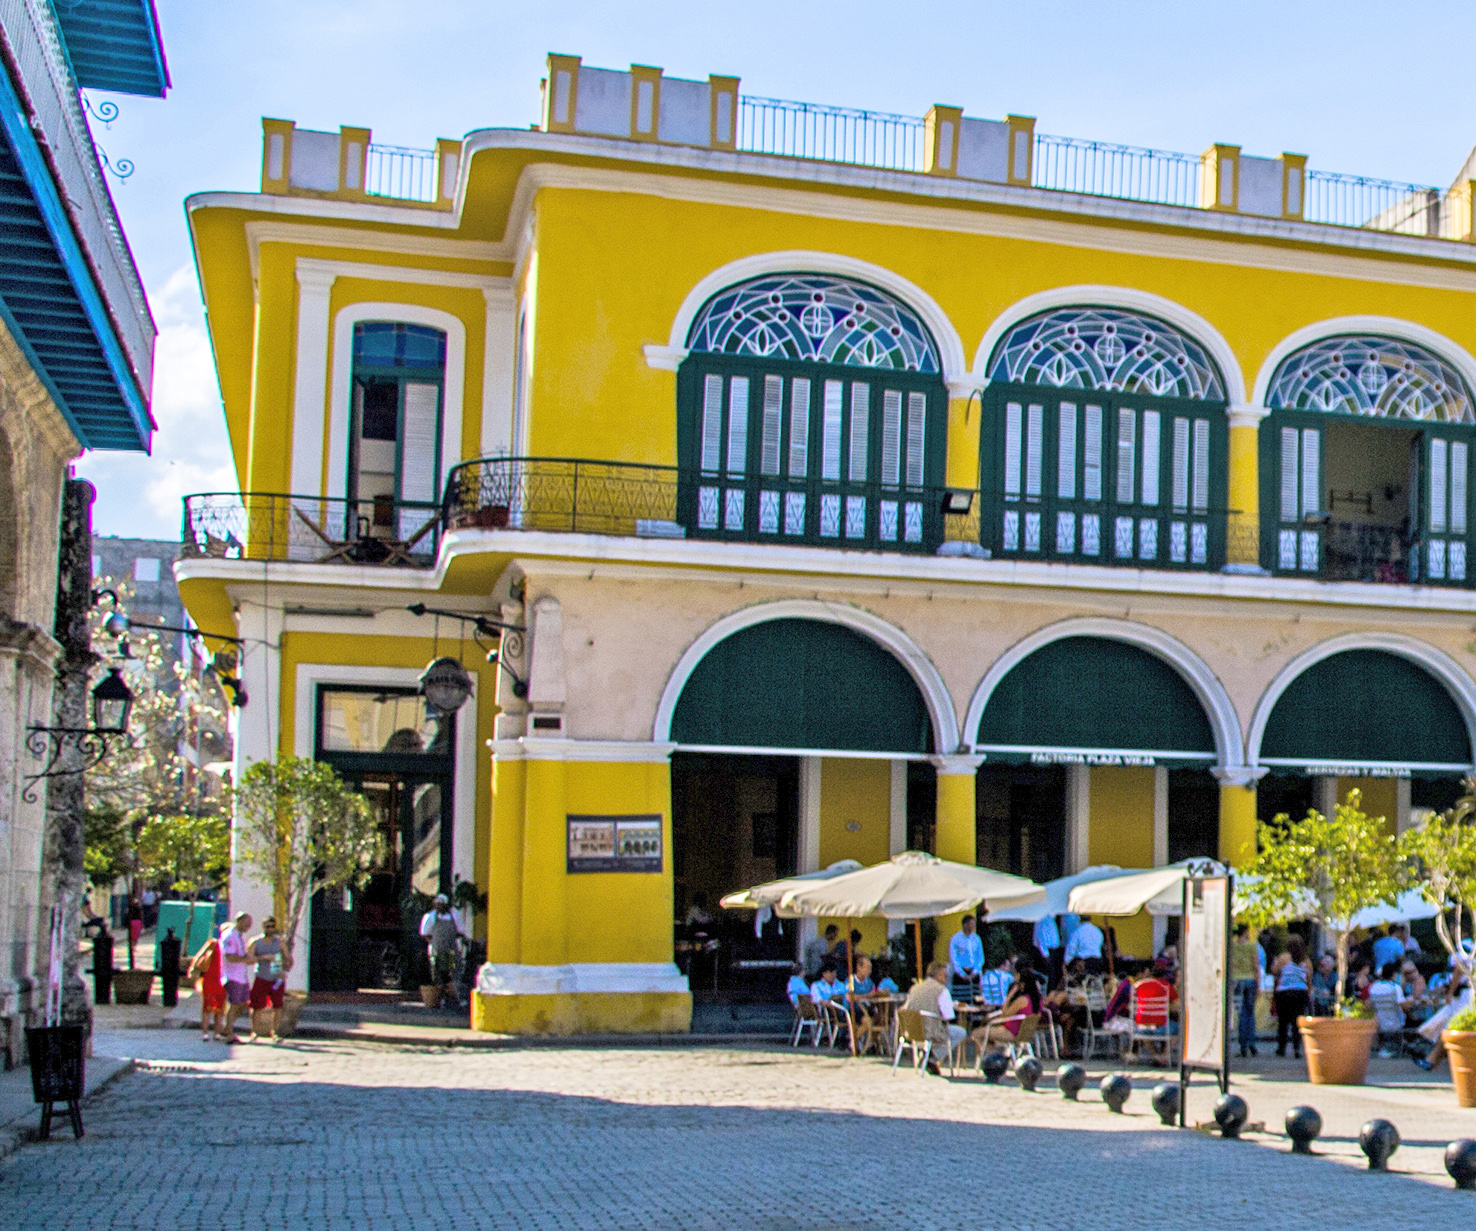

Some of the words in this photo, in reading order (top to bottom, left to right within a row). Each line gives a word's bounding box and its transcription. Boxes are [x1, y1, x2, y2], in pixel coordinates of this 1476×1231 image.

[1031, 752, 1084, 763] FACTORIA
[1087, 754, 1122, 765] PLAZA
[1124, 755, 1155, 766] VIEJA
